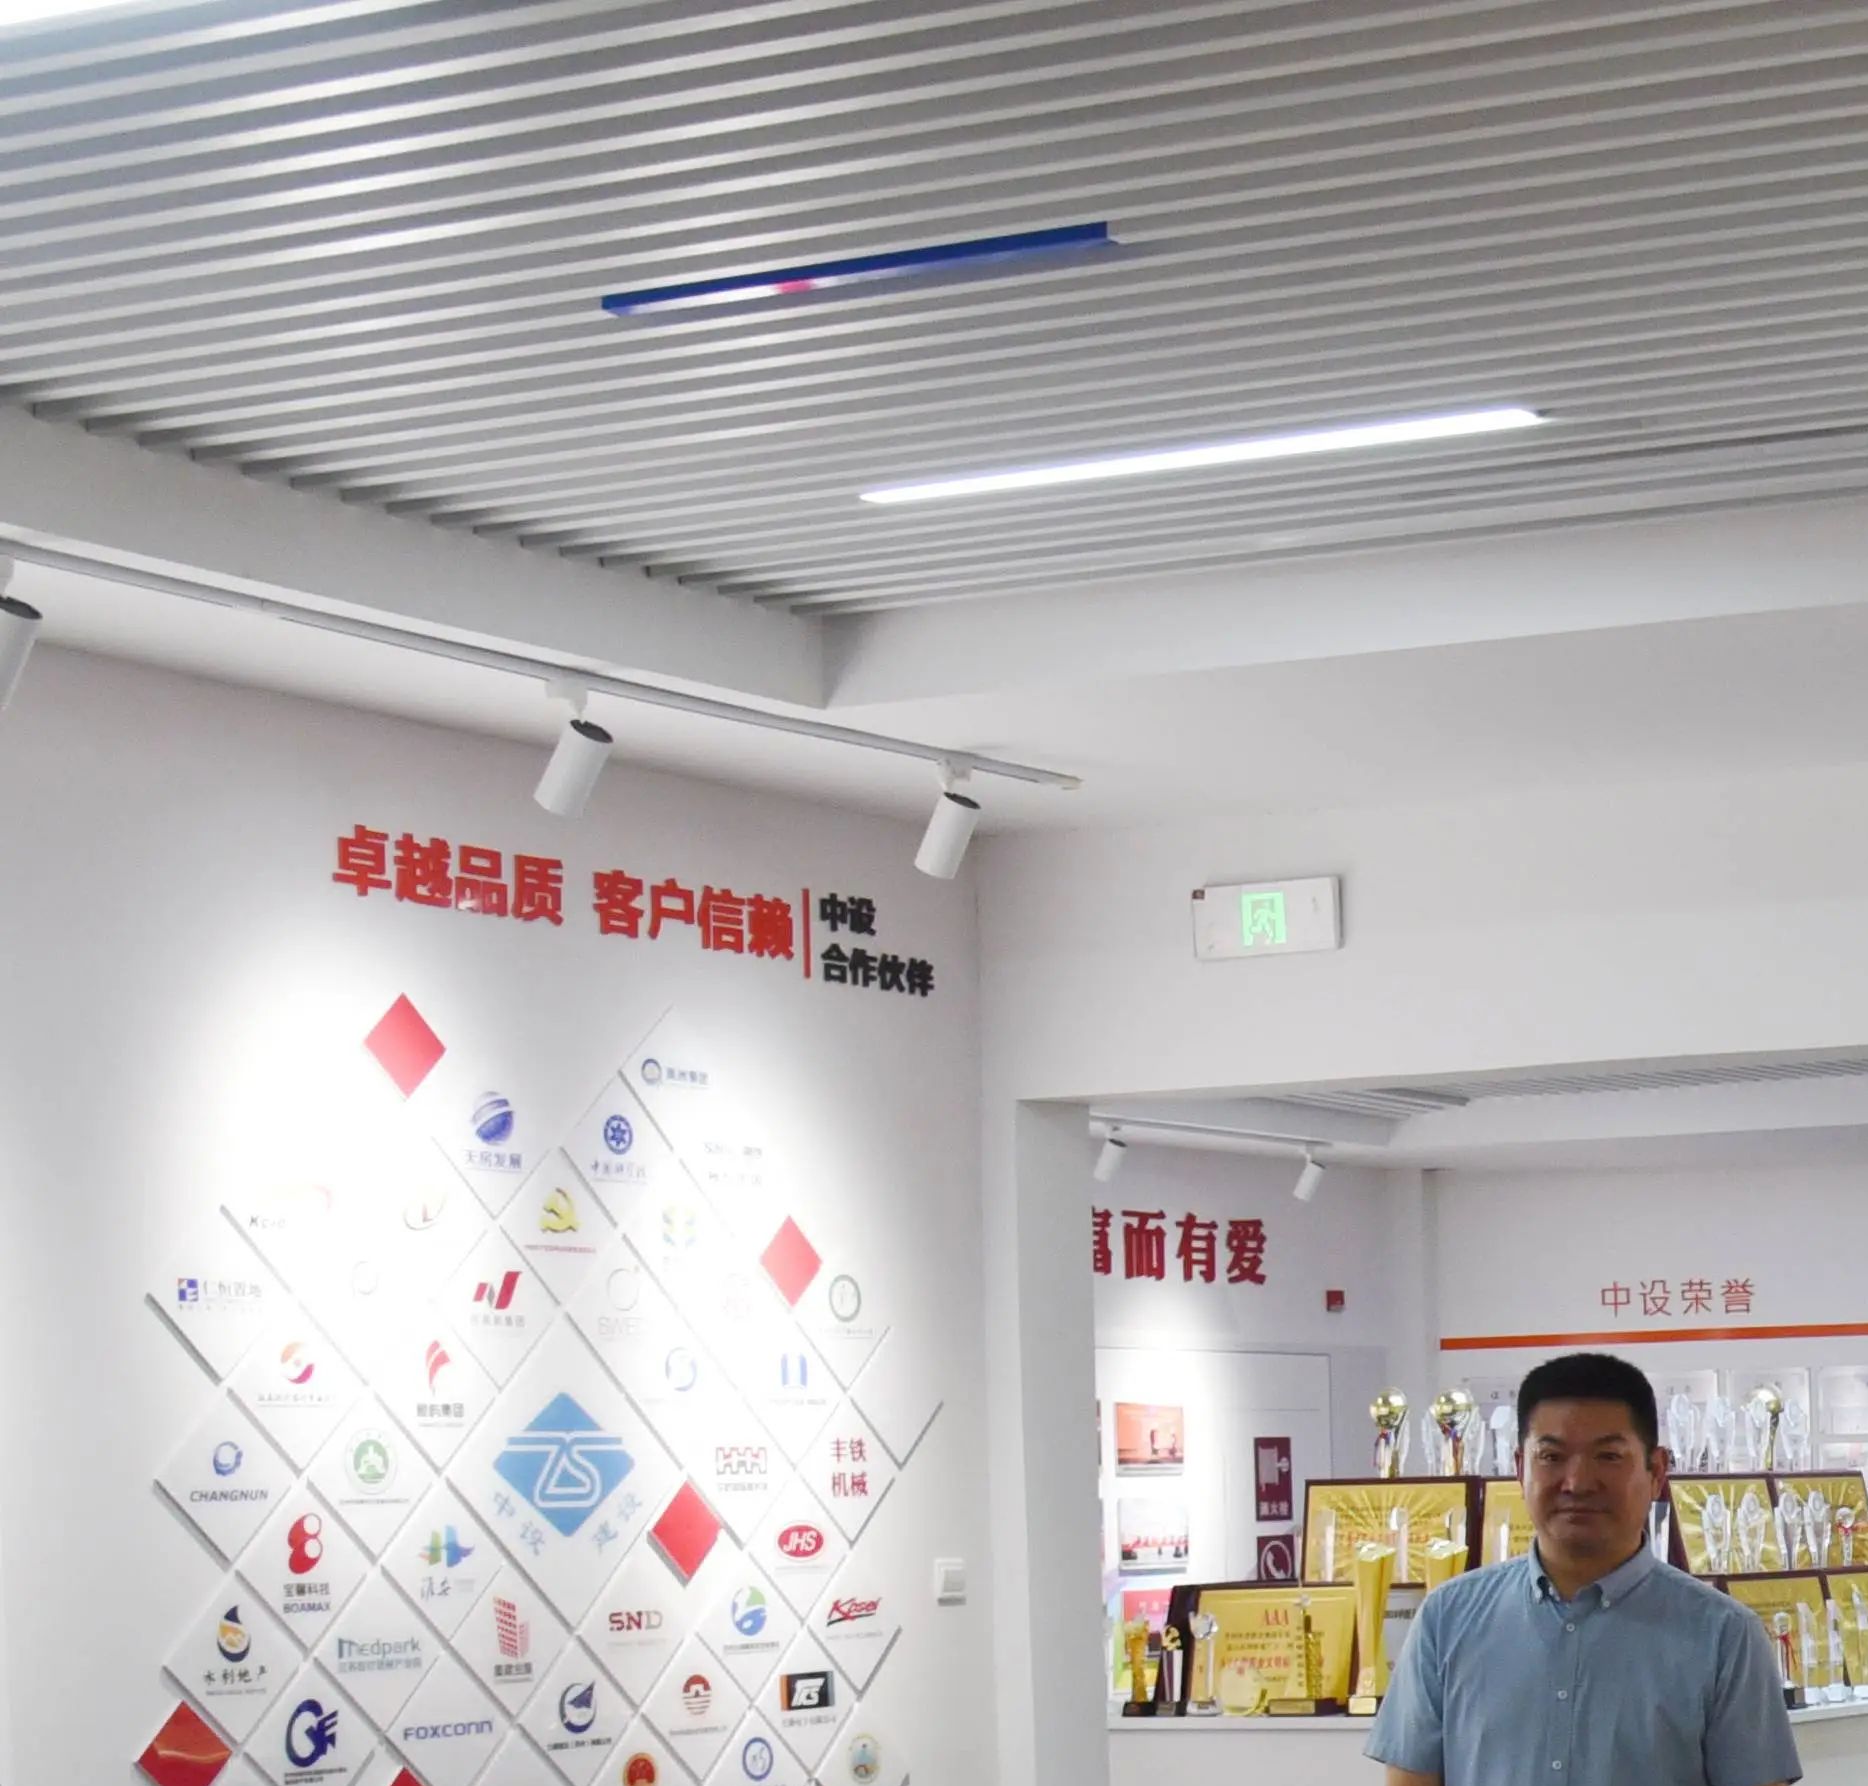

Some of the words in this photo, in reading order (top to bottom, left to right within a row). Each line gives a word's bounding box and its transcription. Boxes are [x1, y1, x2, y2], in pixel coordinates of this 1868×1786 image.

[333, 824, 564, 926] 卓越品质
[592, 869, 795, 961] 客户信赖
[819, 893, 877, 936] 中设
[821, 943, 935, 998] 合作伙伴
[1599, 1278, 1756, 1317] 中设荣誉
[782, 1530, 818, 1553] JHS
[608, 1610, 663, 1632] SND
